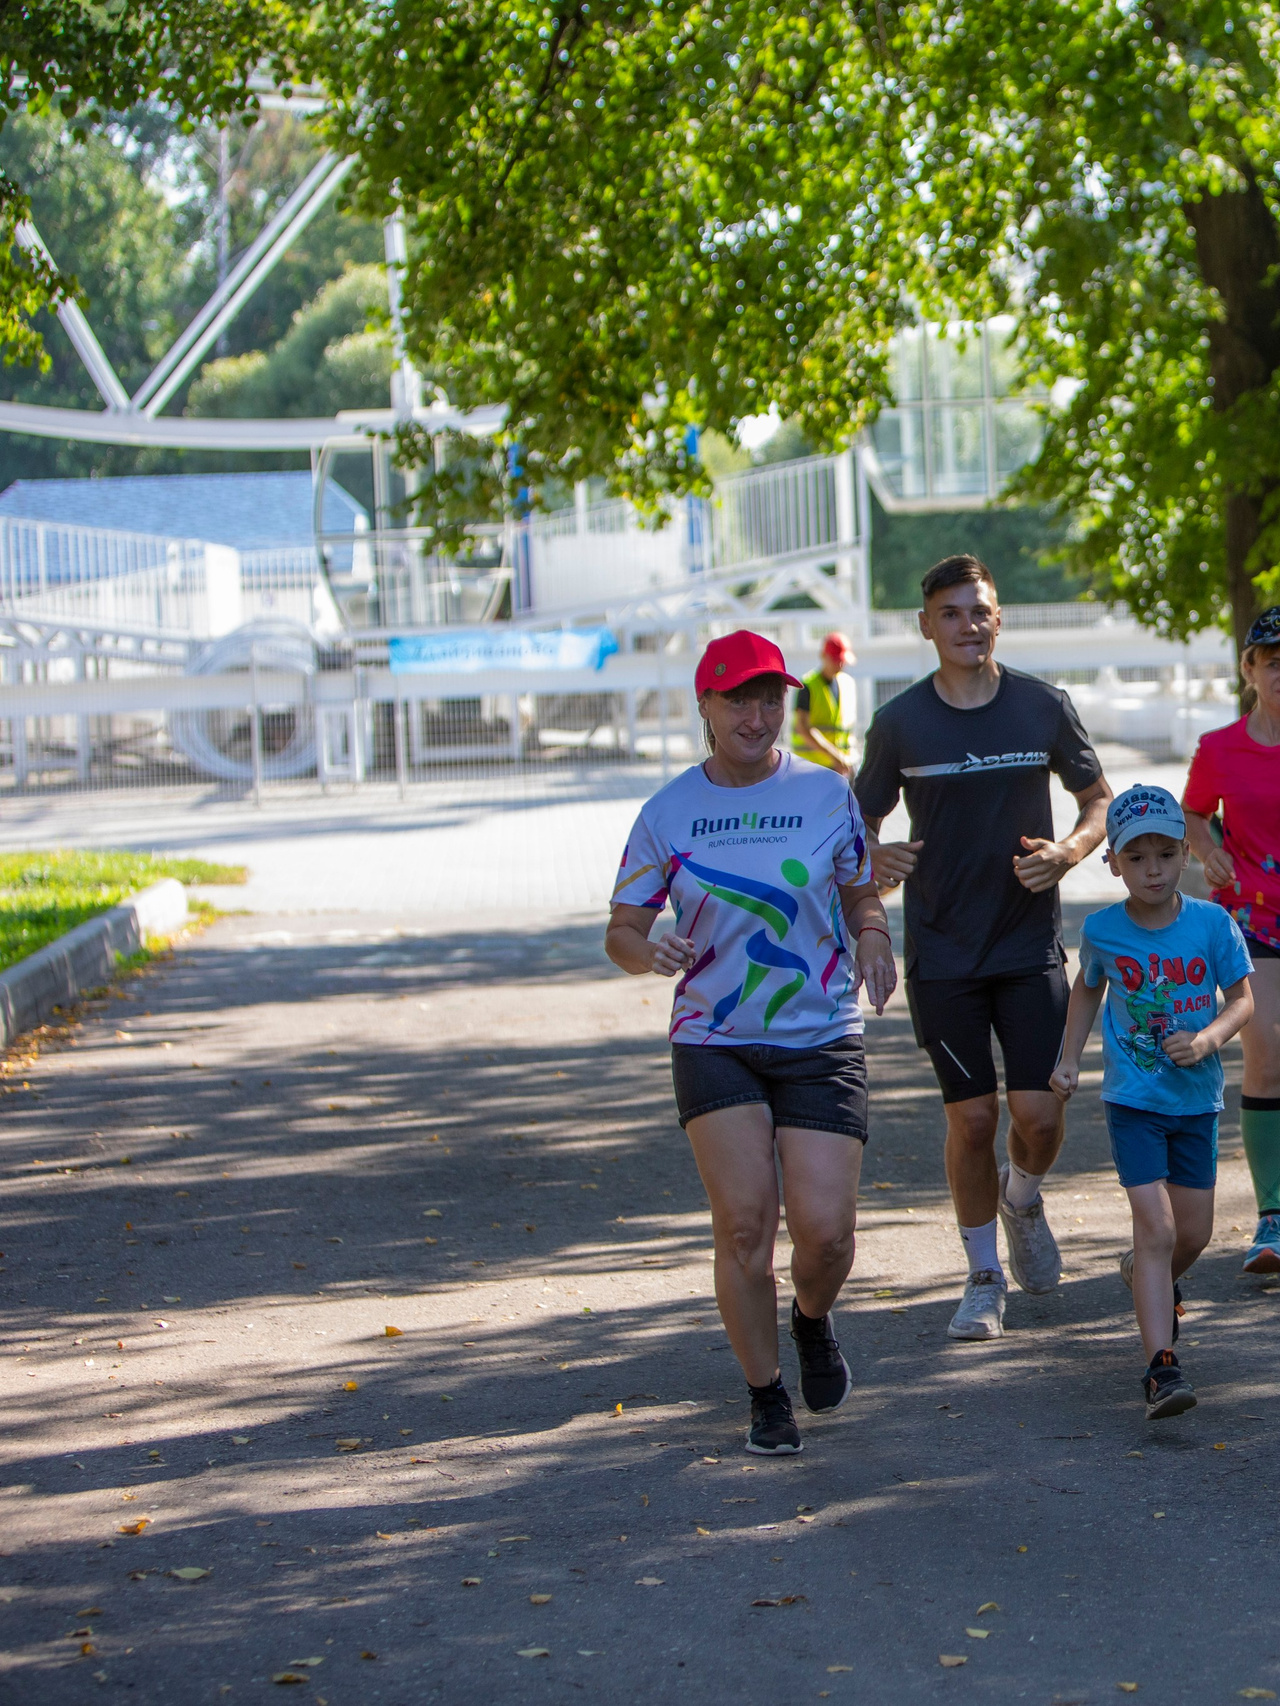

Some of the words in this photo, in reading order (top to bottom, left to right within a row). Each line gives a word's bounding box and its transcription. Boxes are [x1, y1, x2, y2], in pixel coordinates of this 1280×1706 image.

[1117, 813, 1133, 827] NEW
[707, 839, 726, 849] RUN
[726, 837, 748, 846] CLUB
[749, 835, 788, 845] IVANOVO
[1173, 994, 1211, 1014] RACER
